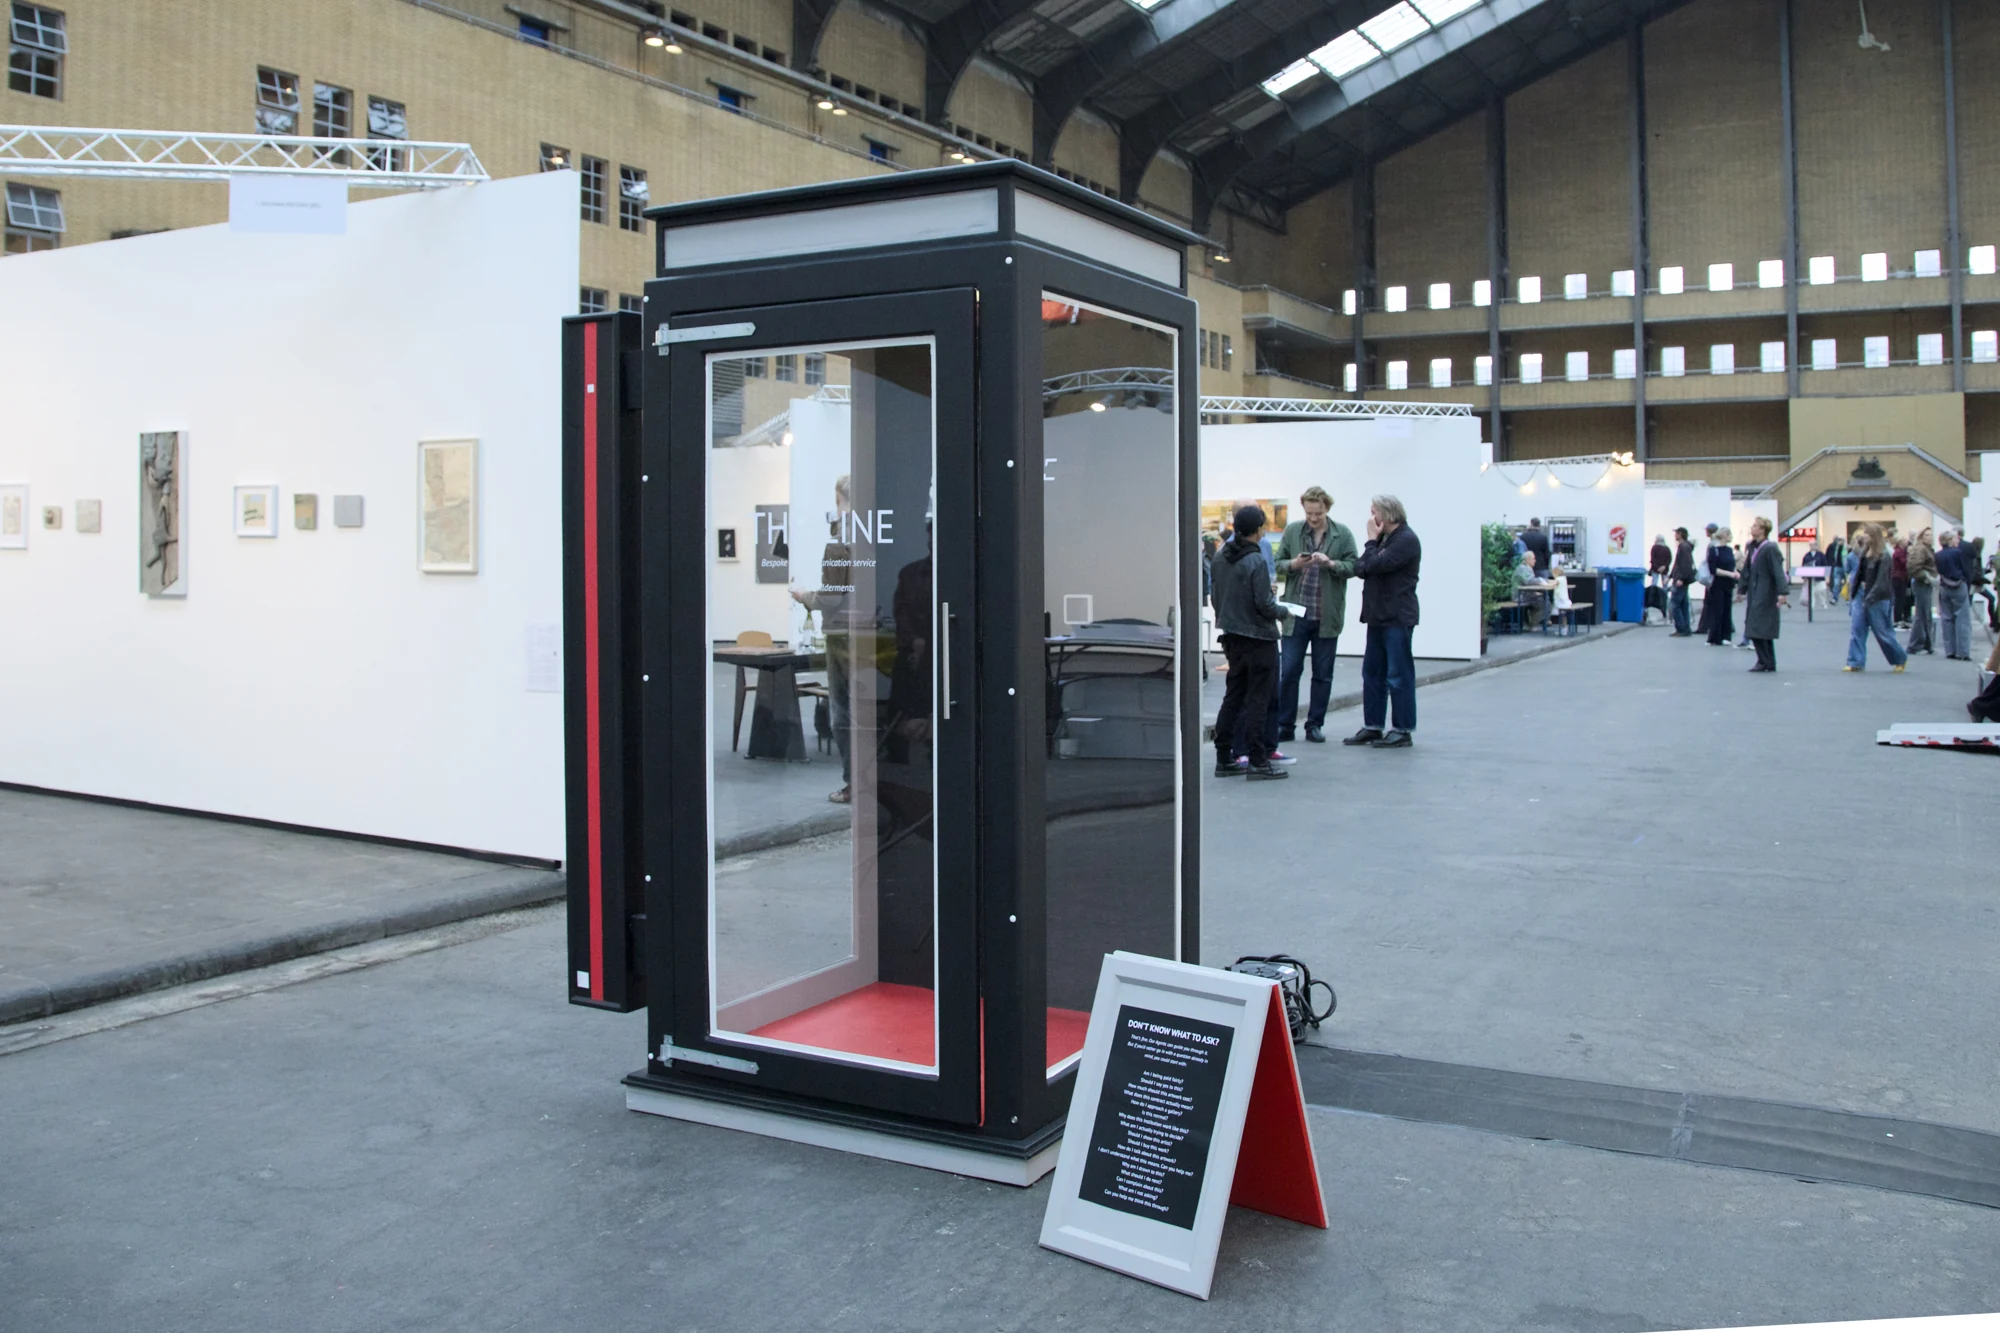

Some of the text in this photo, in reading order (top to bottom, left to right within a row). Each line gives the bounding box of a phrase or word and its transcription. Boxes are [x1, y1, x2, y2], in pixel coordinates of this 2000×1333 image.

[761, 558, 788, 568] Bespoke
[852, 558, 877, 567] service
[1128, 1020, 1219, 1046] DON'T KNOW WHAT TO ASK?
